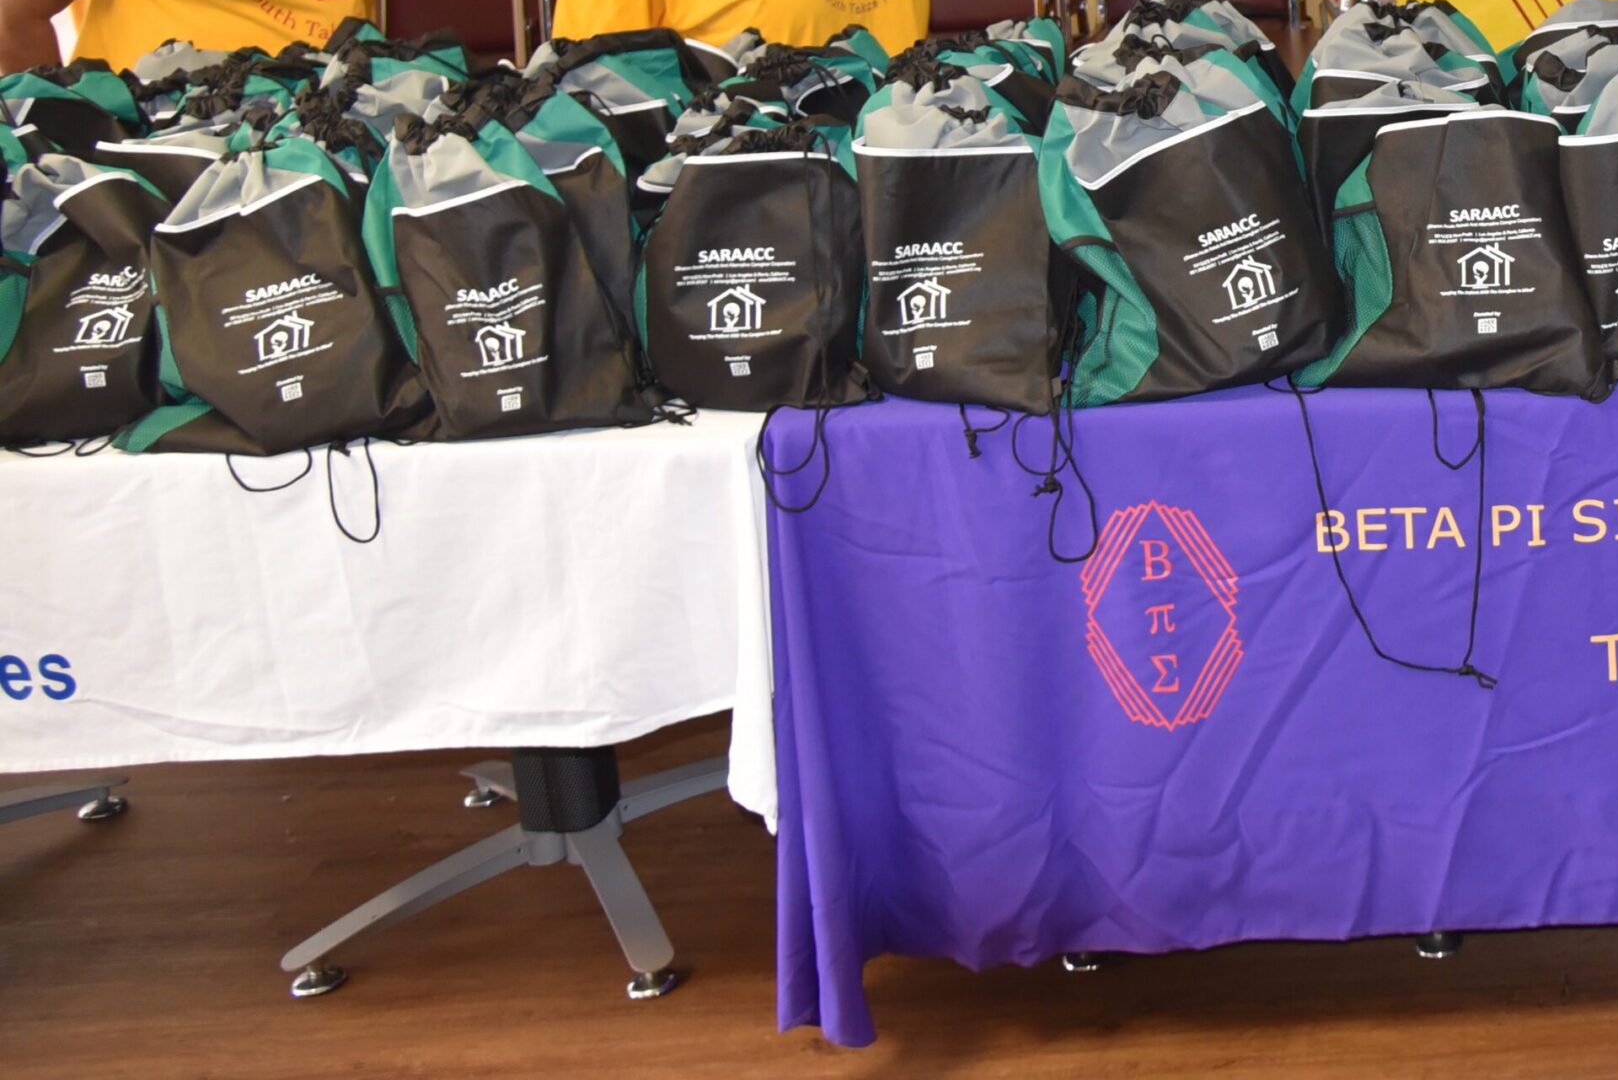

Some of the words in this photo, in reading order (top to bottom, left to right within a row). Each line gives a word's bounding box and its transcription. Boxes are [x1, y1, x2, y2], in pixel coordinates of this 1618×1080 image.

[1449, 204, 1521, 223] SARAACC
[1198, 213, 1261, 248] SARAACC
[697, 246, 776, 264] SARAACC
[894, 241, 964, 260] SARAACC
[1315, 506, 1466, 553] BETA
[1491, 503, 1546, 547] PI
[0, 653, 77, 700] es
